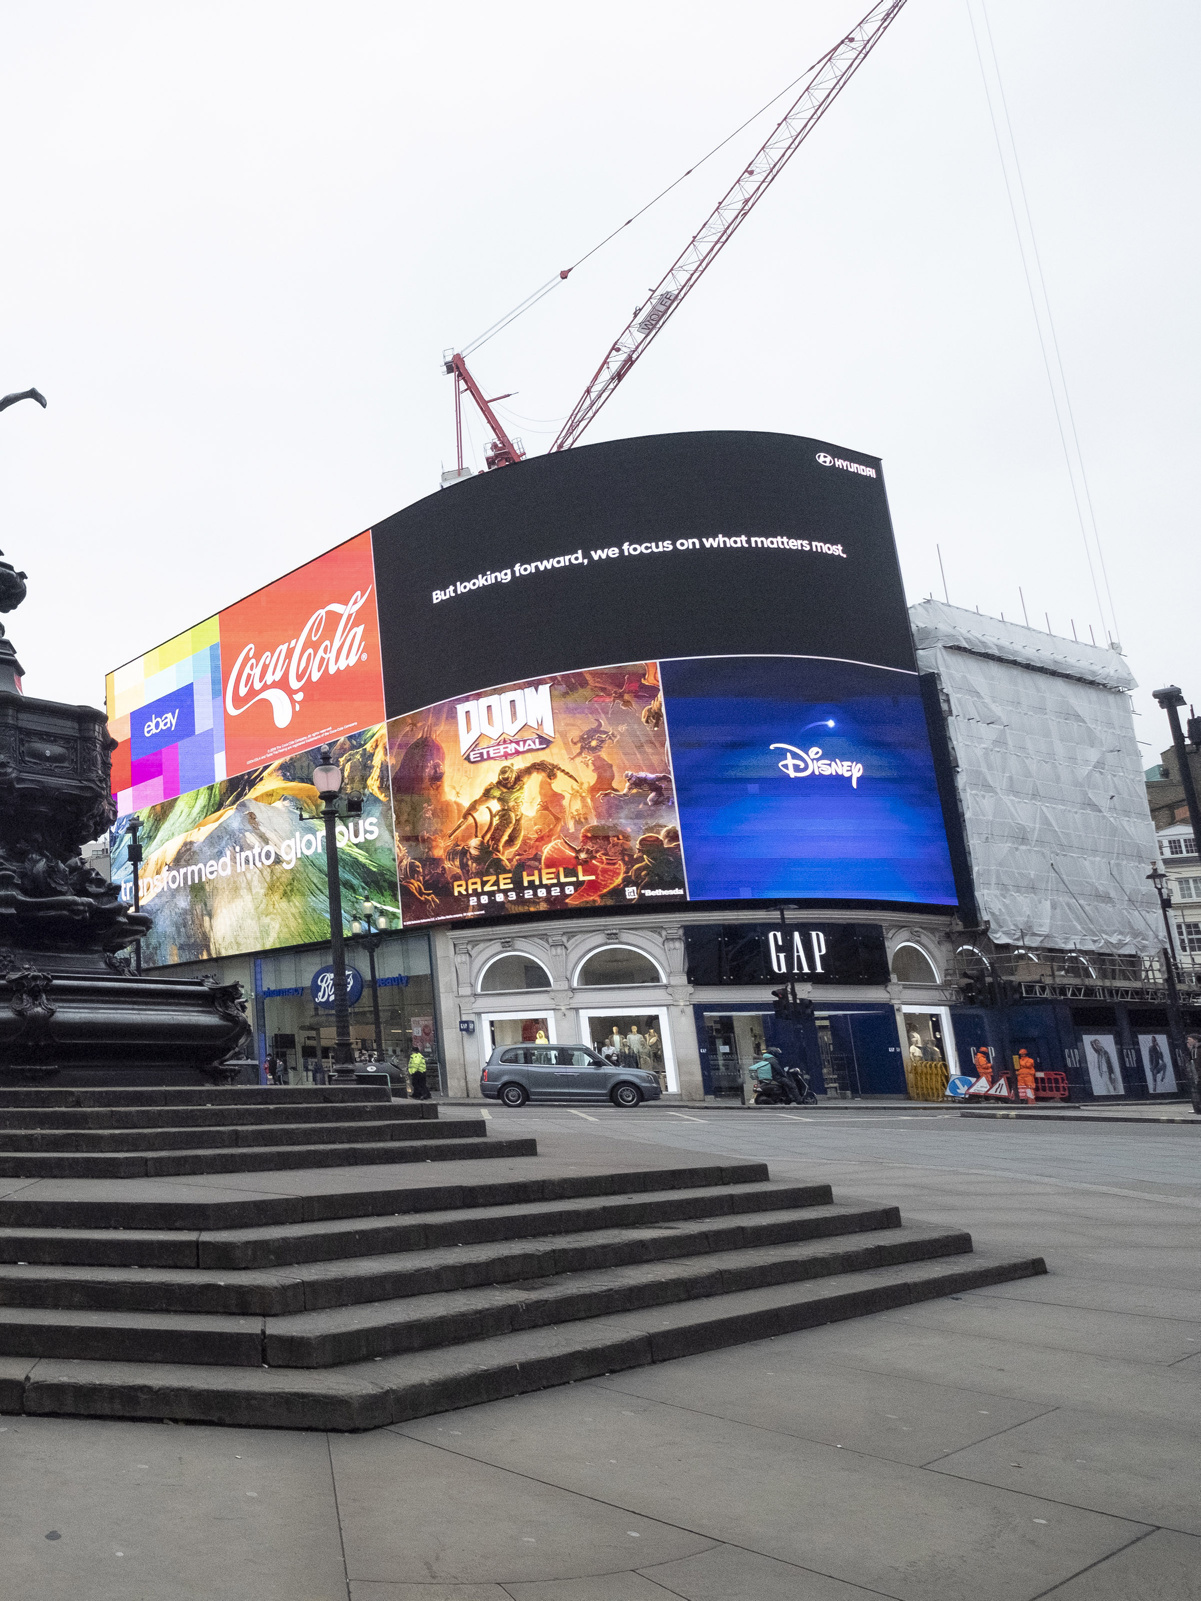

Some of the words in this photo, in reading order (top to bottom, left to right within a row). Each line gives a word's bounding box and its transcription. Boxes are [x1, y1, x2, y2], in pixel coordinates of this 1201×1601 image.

[834, 457, 877, 479] HYUNDAI
[432, 585, 455, 604] But
[456, 568, 512, 595] looking
[513, 549, 589, 577] forward,
[590, 546, 620, 561] we
[621, 538, 673, 556] focus
[675, 536, 700, 550] on
[701, 533, 749, 549] what
[750, 536, 811, 551] matters
[811, 539, 847, 558] most.
[225, 583, 372, 728] Coca-Cola
[143, 708, 180, 737] ebay
[455, 682, 555, 757] DOOM
[469, 738, 547, 762] ETERNAL
[769, 743, 863, 789] Disney
[235, 841, 276, 874] into
[280, 816, 379, 870] glorous
[453, 873, 514, 897] RAZE
[522, 865, 596, 887] HELL
[641, 887, 685, 897] Bethesda
[768, 931, 826, 973] GAP
[970, 1046, 995, 1064] GP
[1064, 1048, 1080, 1067] GAP
[1123, 1048, 1136, 1067] GAP
